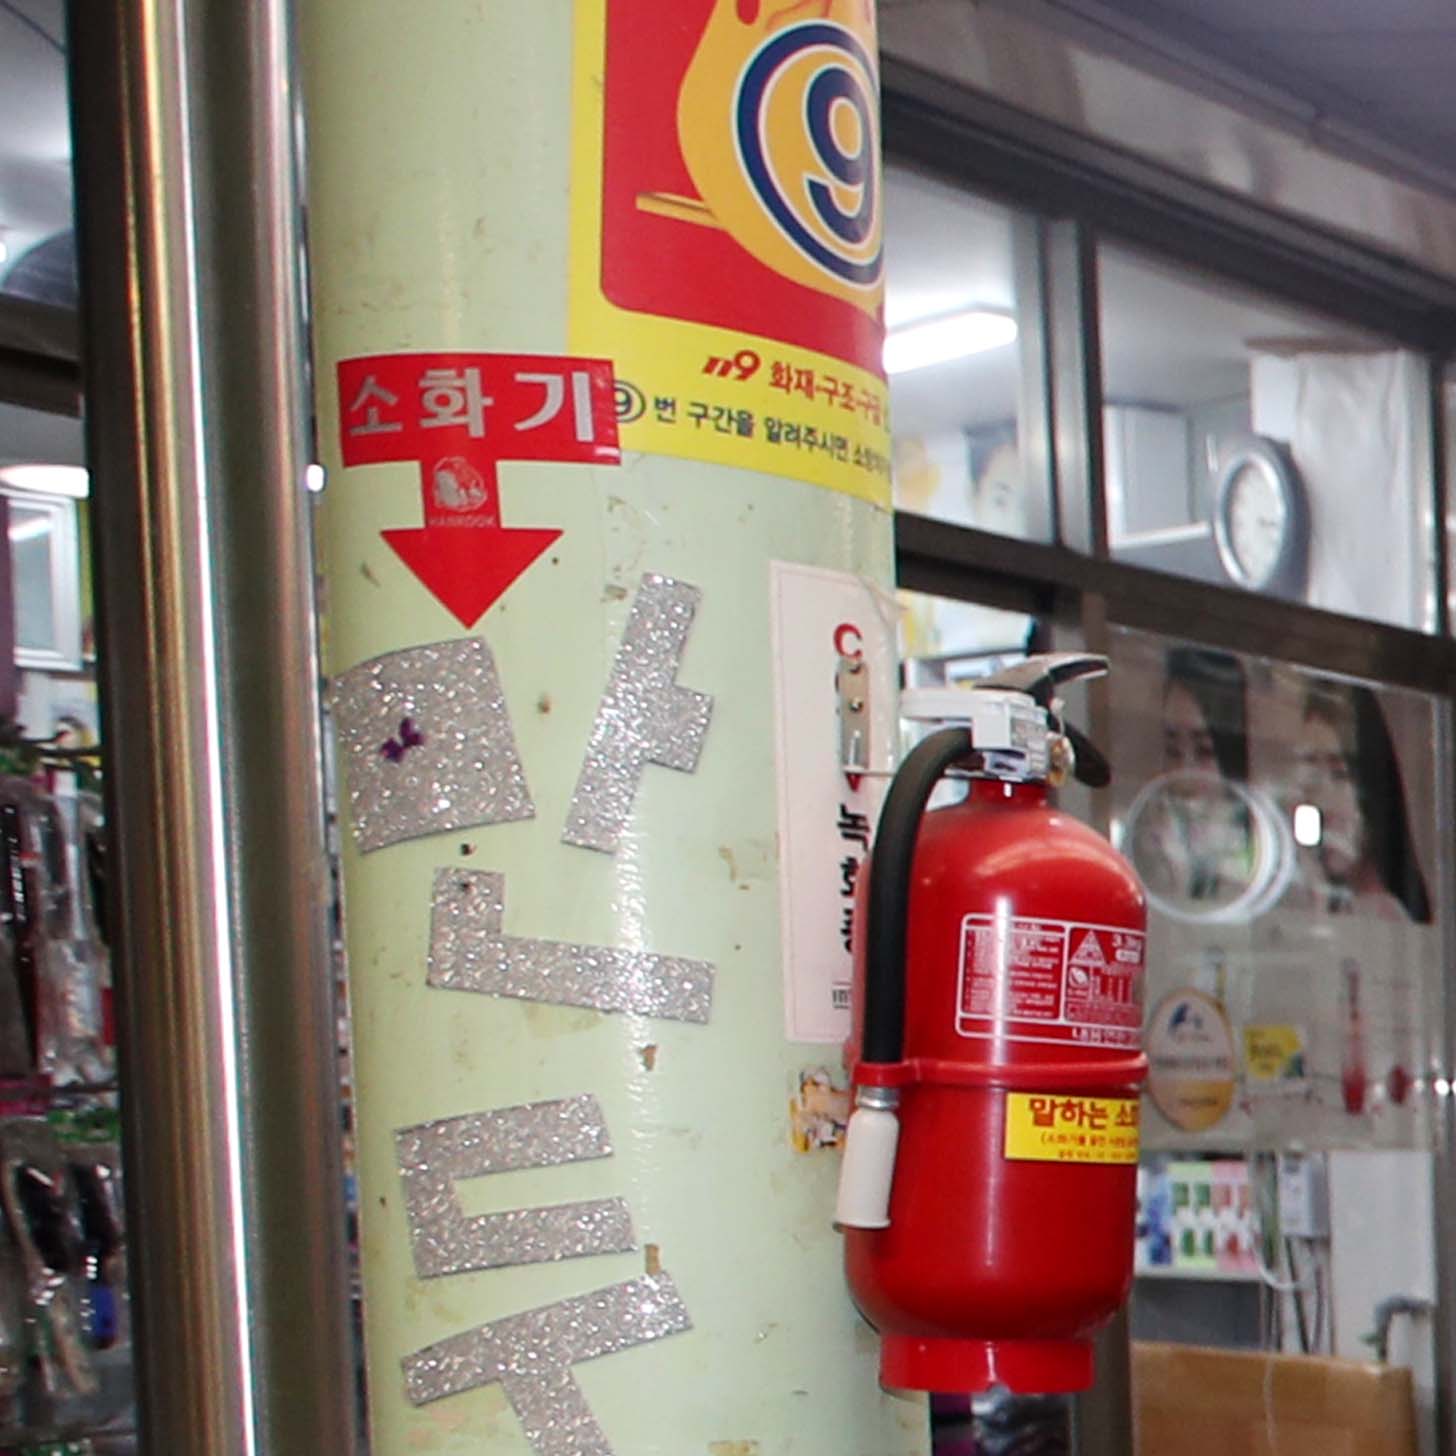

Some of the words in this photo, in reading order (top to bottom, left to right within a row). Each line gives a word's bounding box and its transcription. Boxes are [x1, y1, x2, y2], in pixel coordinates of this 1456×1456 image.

[350, 367, 596, 443] 소화기
[1029, 1098, 1108, 1130] 말하는
[1114, 1102, 1139, 1128] 소
